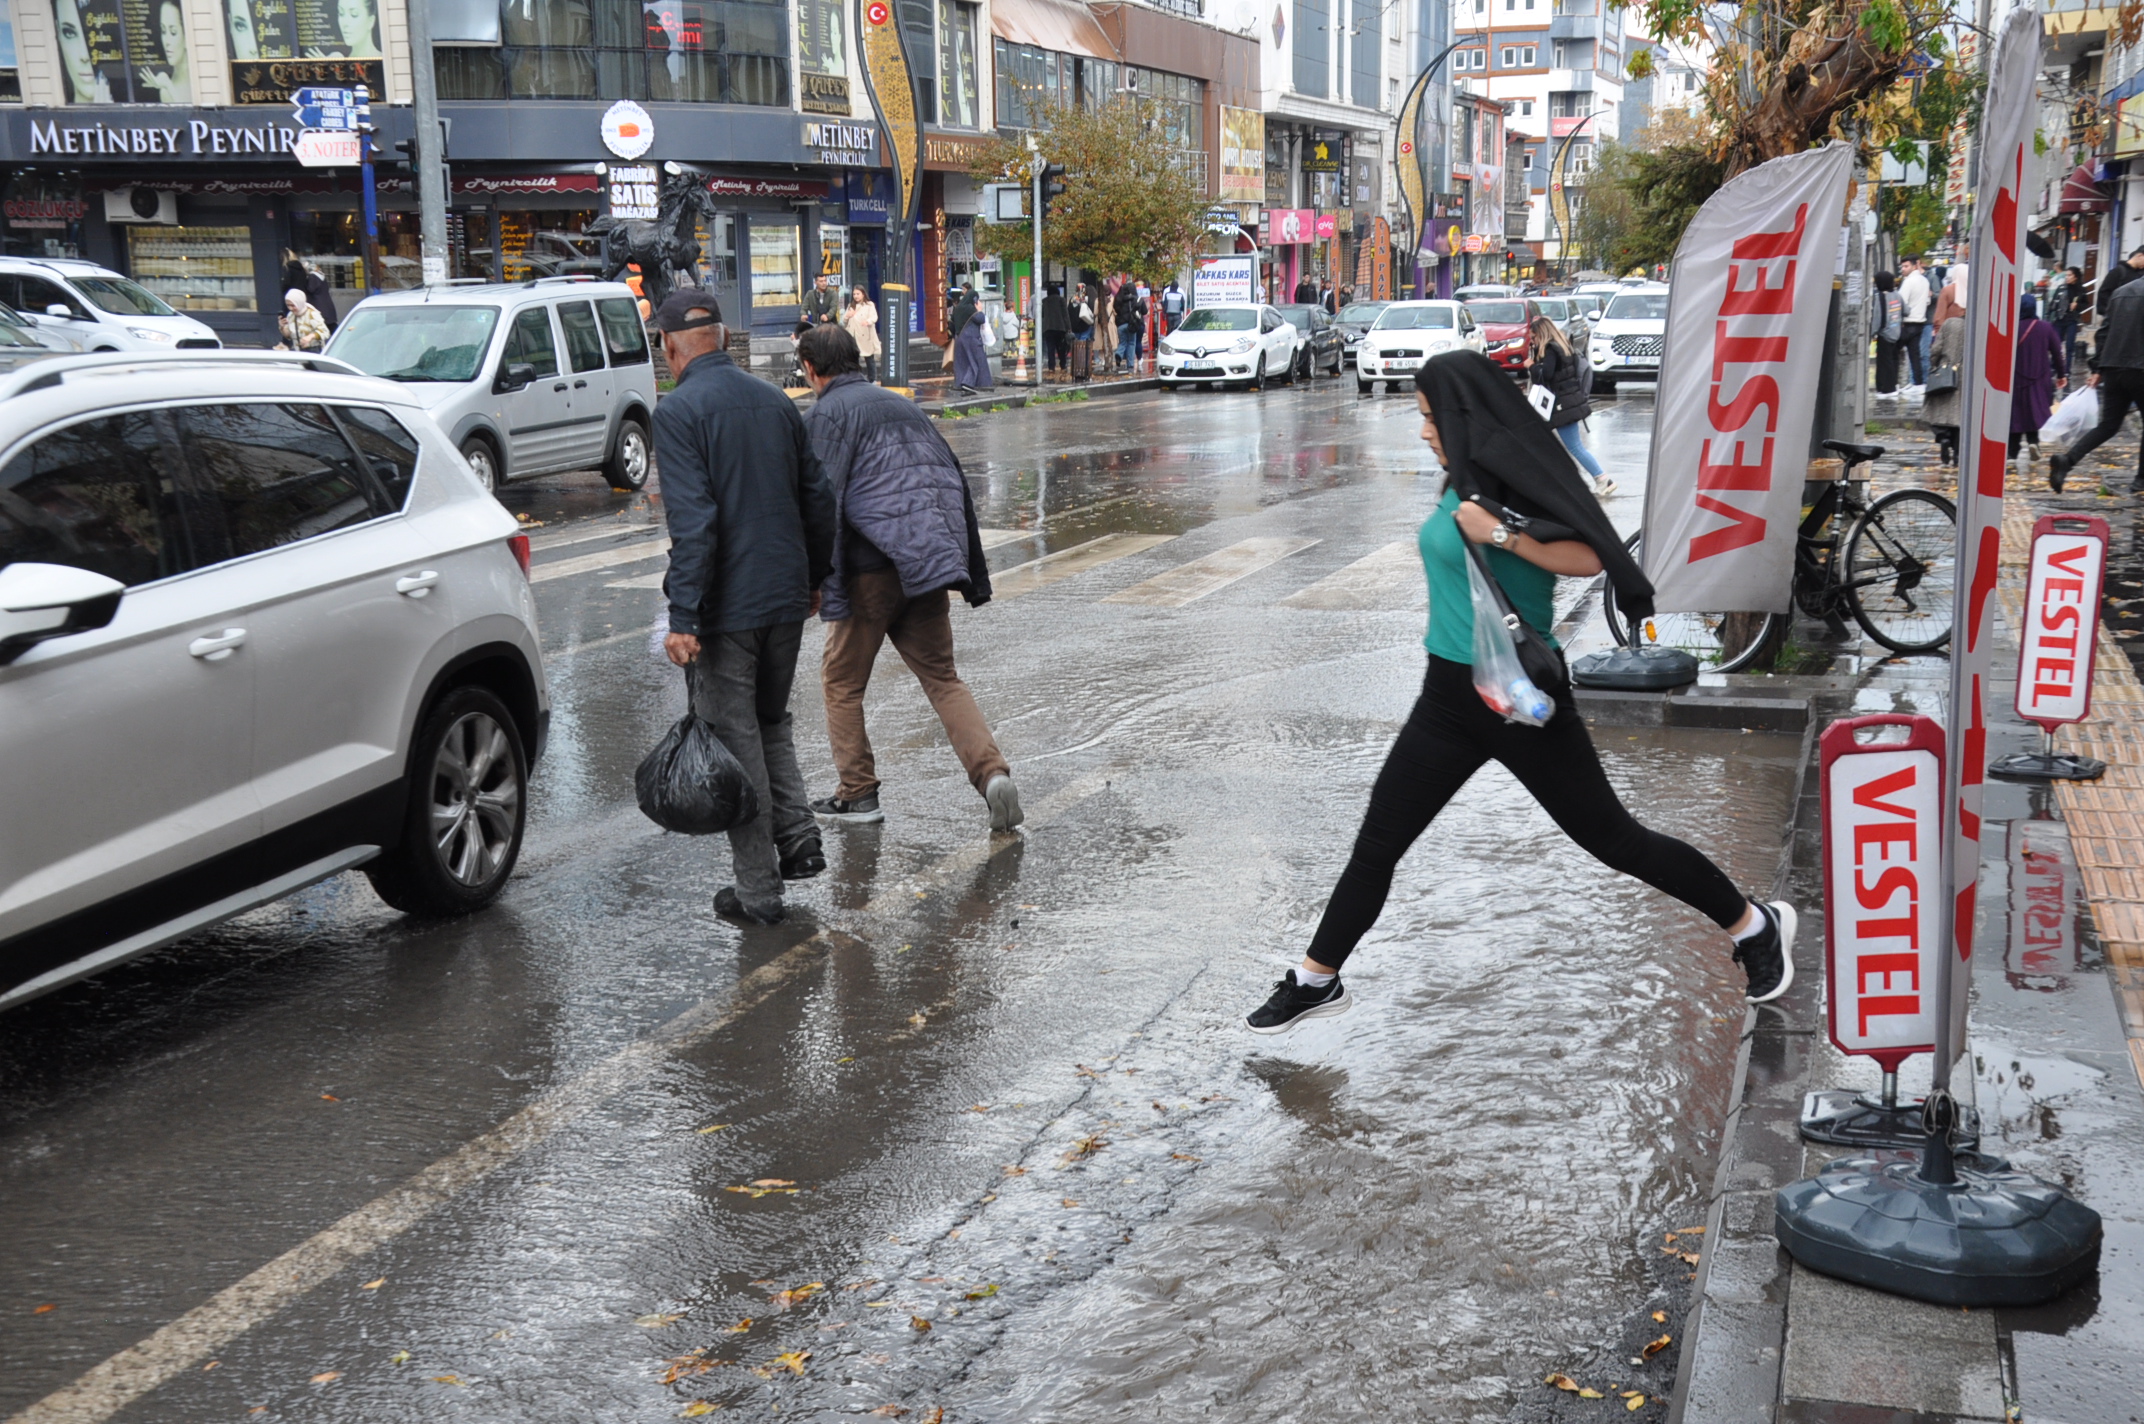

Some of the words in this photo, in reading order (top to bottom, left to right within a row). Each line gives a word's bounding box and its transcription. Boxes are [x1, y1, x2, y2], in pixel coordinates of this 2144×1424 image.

[269, 62, 373, 87] QUEEN
[810, 119, 875, 150] METİNBEY
[301, 143, 311, 158] 3.
[314, 141, 359, 158] NOTER
[1242, 148, 1262, 169] HOUSE
[465, 178, 557, 190] Peynircilik
[609, 165, 657, 182] FABRİKA
[204, 180, 293, 192] Peynircilik
[611, 184, 657, 206] SATIŞ
[712, 180, 751, 192] Metinbey
[756, 182, 800, 193] Peynircilik
[850, 199, 886, 211] TURKCELL
[822, 249, 832, 275] 2
[832, 260, 841, 274] AY
[1195, 270, 1228, 280] KAFKAS
[1228, 270, 1250, 279] KARS
[1686, 202, 1808, 565] VESTEL
[2030, 544, 2088, 708] VESTEL
[1852, 764, 1921, 1038] VESTEL
